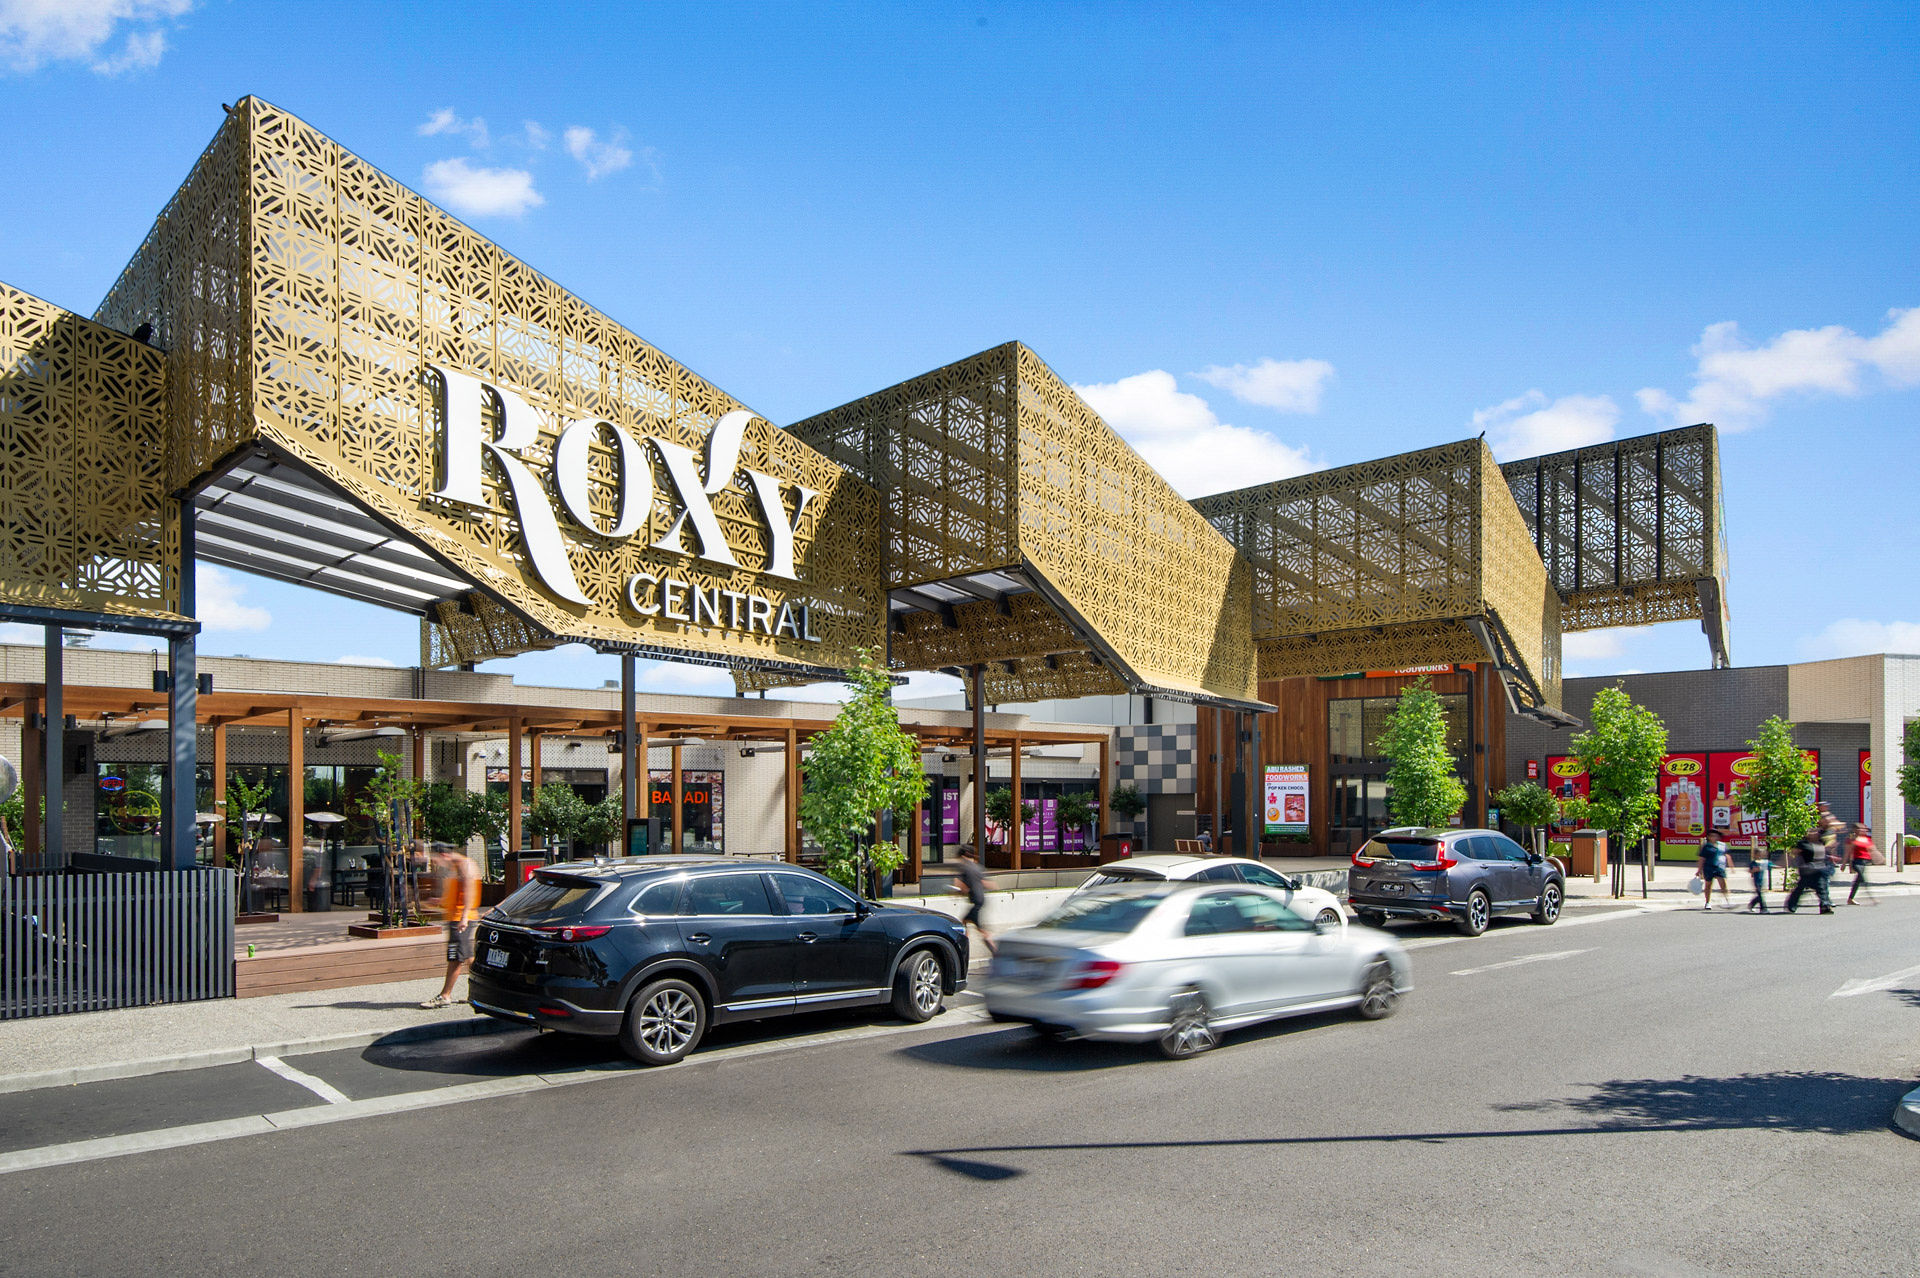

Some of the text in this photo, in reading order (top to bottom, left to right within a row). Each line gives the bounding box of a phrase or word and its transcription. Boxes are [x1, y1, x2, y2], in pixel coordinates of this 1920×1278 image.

[426, 364, 820, 606] ROXY
[627, 573, 822, 643] CENTRAL
[99, 779, 125, 788] OPEN
[652, 791, 709, 804] BAADI
[1741, 820, 1767, 835] BIG
